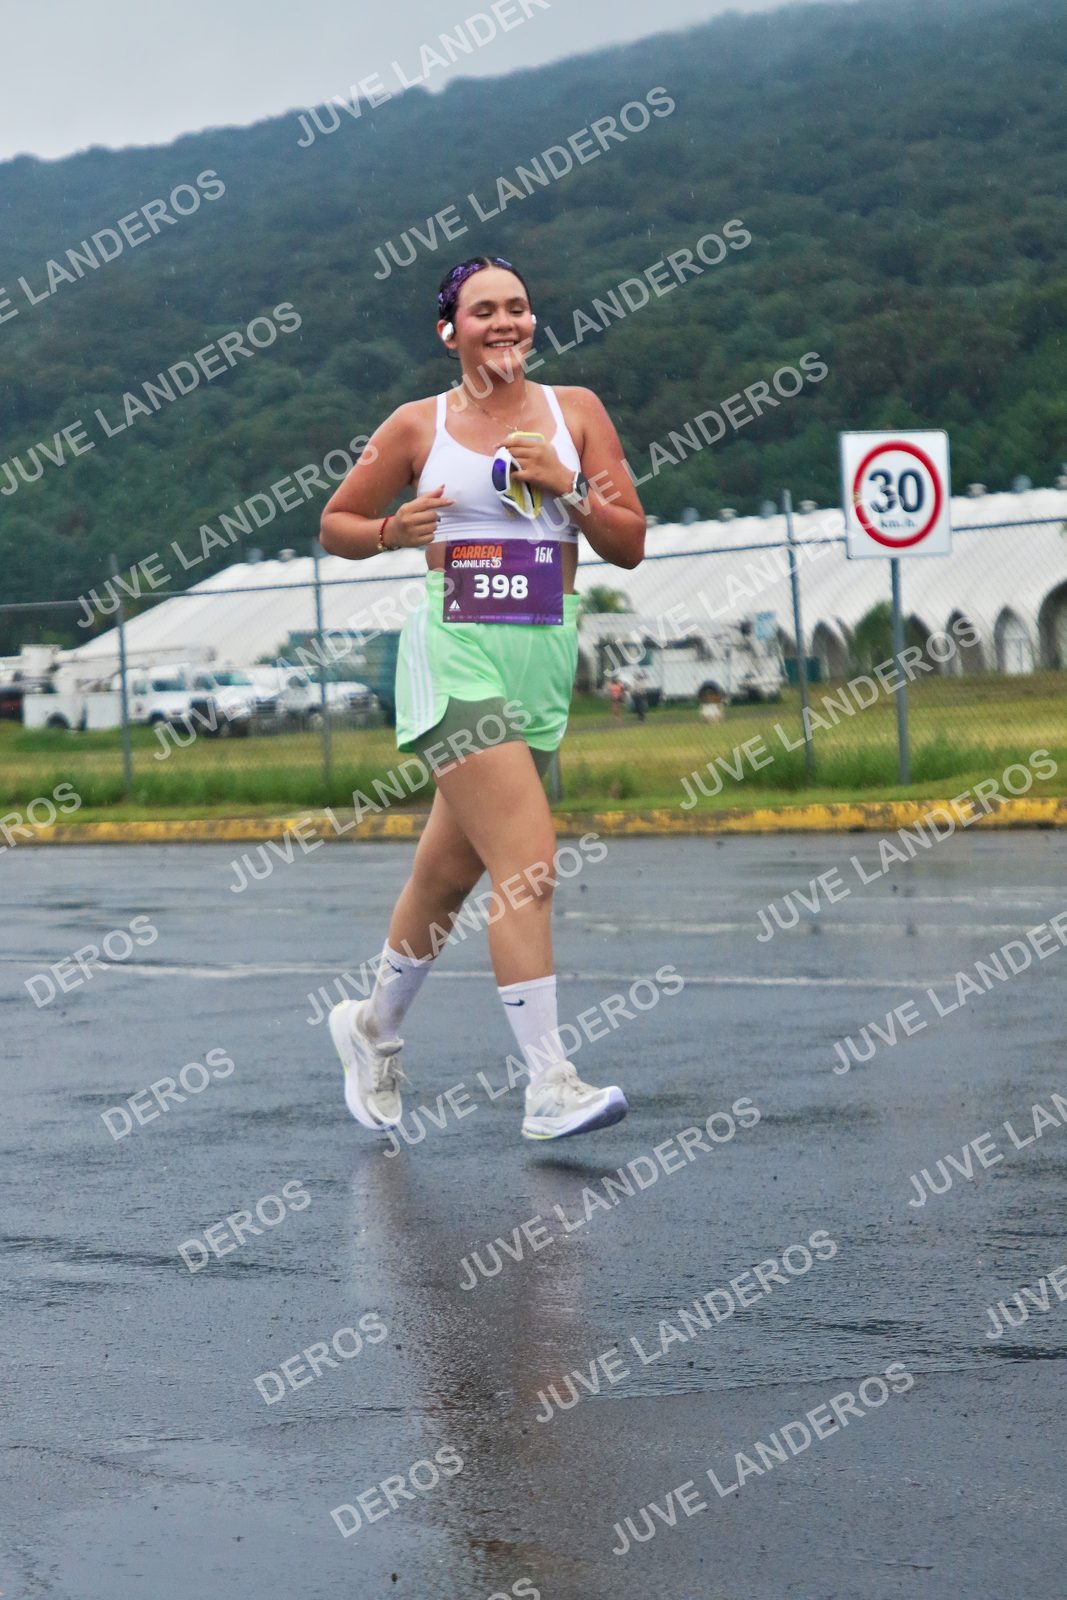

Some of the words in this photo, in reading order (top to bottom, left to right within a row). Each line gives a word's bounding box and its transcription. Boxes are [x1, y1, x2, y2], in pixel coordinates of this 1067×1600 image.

[869, 468, 924, 513] 30
[452, 545, 503, 559] CARRERA
[534, 546, 553, 563] 15K
[451, 559, 490, 568] OMNILIFE
[473, 573, 529, 599] 398
